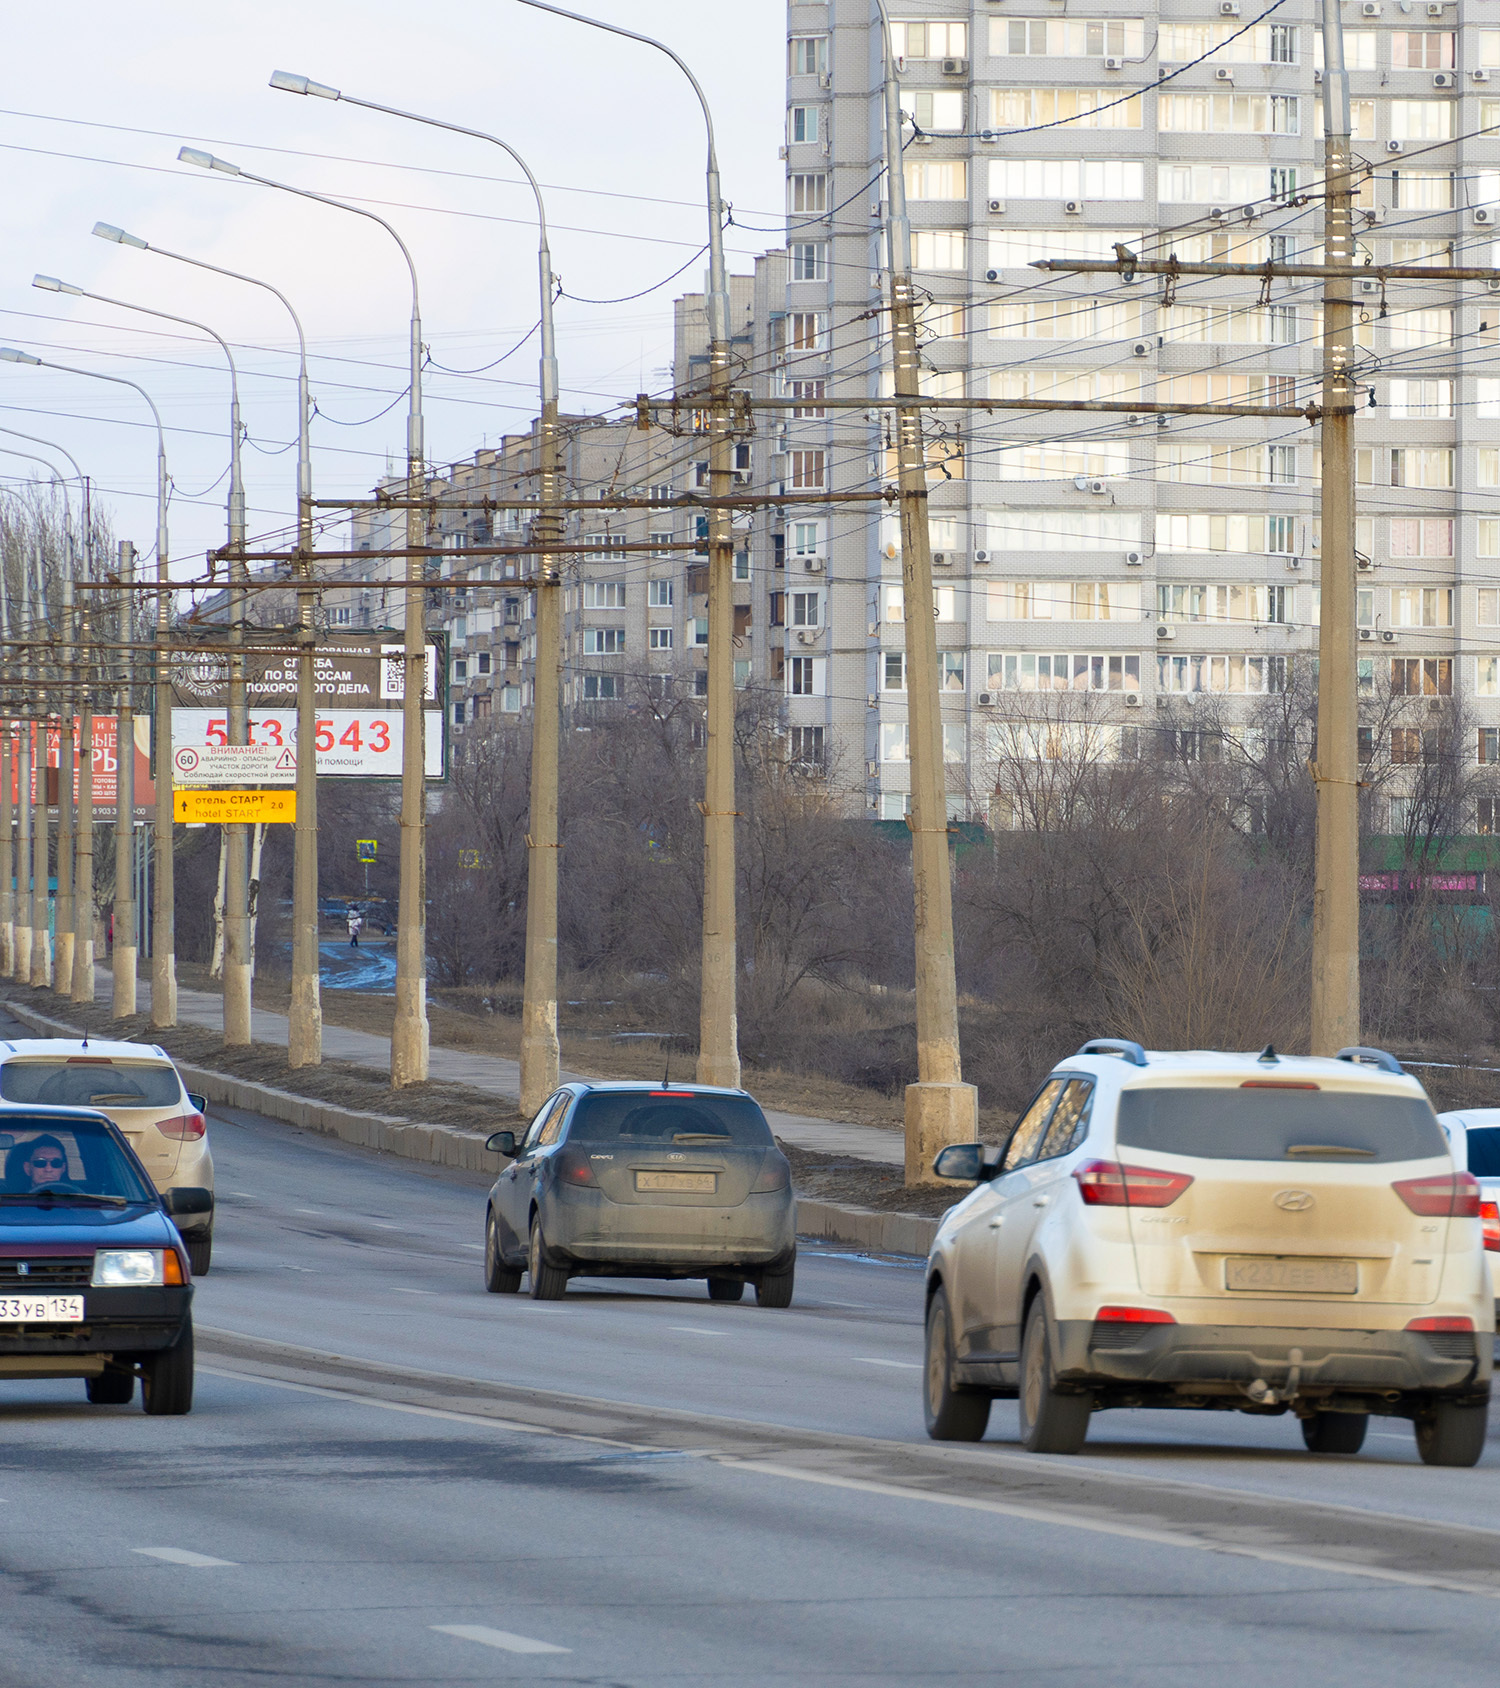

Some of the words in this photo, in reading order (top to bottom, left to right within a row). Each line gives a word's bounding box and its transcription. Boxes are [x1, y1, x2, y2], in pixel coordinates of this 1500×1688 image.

[265, 670, 282, 680] ПО
[337, 683, 370, 695] ДЕЛА
[315, 720, 391, 752] 543
[211, 746, 268, 755] ВНИМАНИЕ!
[180, 755, 194, 765] 60
[230, 796, 265, 804] СТАРТ
[195, 809, 221, 818] hotel
[225, 809, 261, 818] START
[51, 1298, 80, 1313] 134
